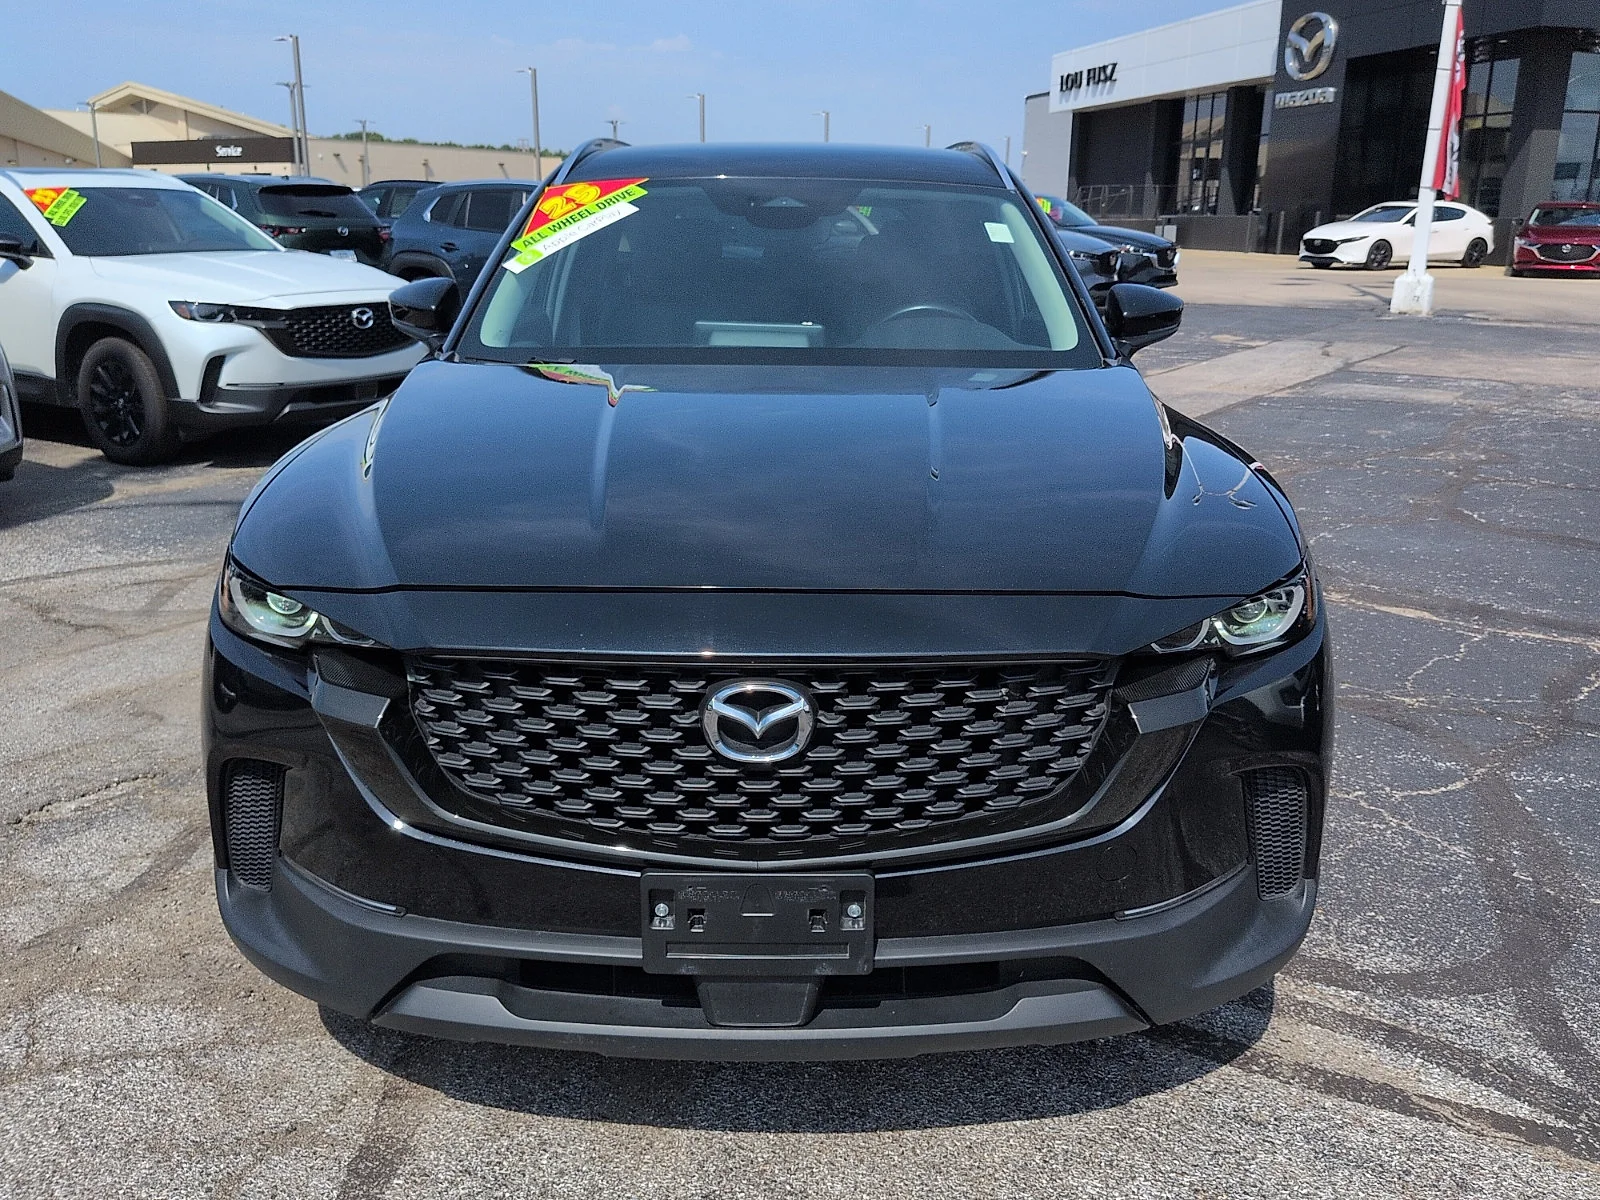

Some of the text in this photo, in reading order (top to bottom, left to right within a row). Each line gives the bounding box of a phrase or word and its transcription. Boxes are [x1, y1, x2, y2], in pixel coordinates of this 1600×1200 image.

[1060, 62, 1118, 92] LOU FUSZ
[538, 182, 601, 219] 25
[521, 188, 635, 249] ALL WHEEL DRIVE
[543, 231, 575, 251] Apple
